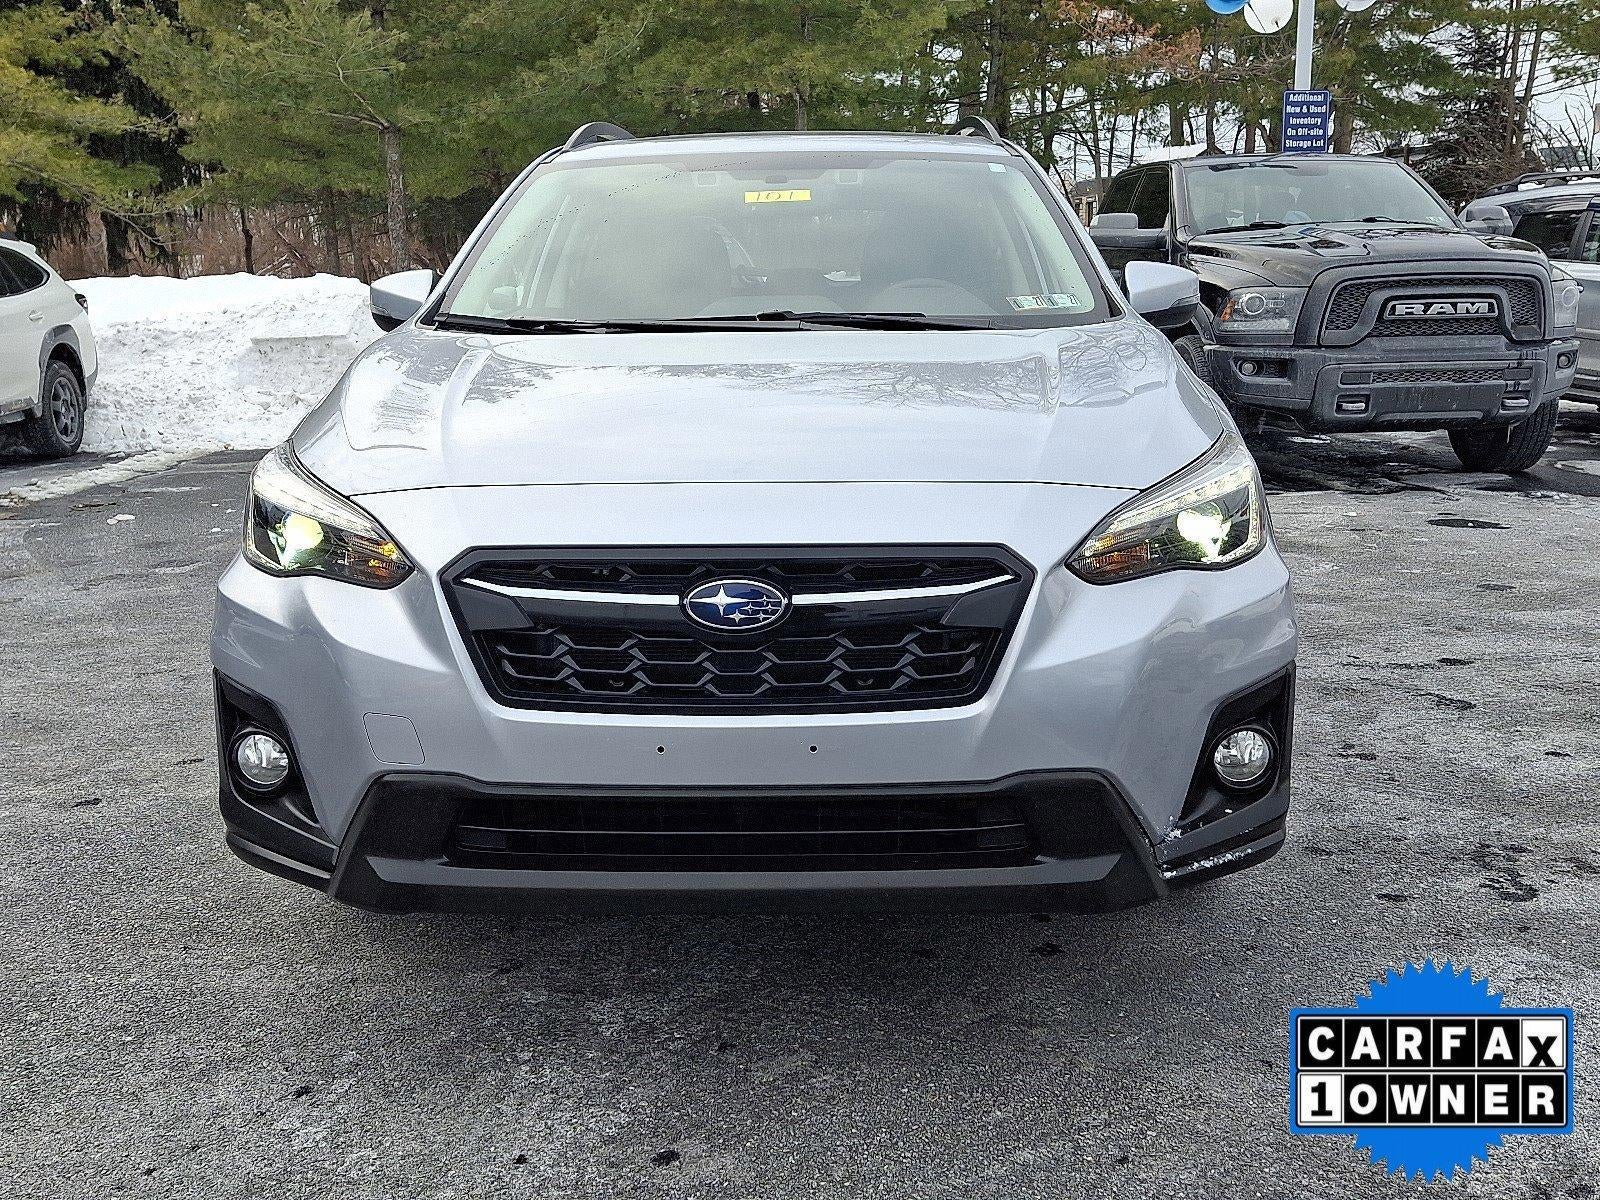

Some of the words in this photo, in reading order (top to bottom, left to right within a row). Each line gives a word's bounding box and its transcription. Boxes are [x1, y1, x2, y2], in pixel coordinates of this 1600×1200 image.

[1286, 105, 1300, 113] New
[1302, 105, 1307, 113] &
[1309, 105, 1326, 113] Used
[1289, 117, 1321, 125] Inventory
[1285, 140, 1311, 148] Storage
[1313, 139, 1323, 147] Lot
[756, 191, 793, 201] 101
[1395, 302, 1489, 315] RAM
